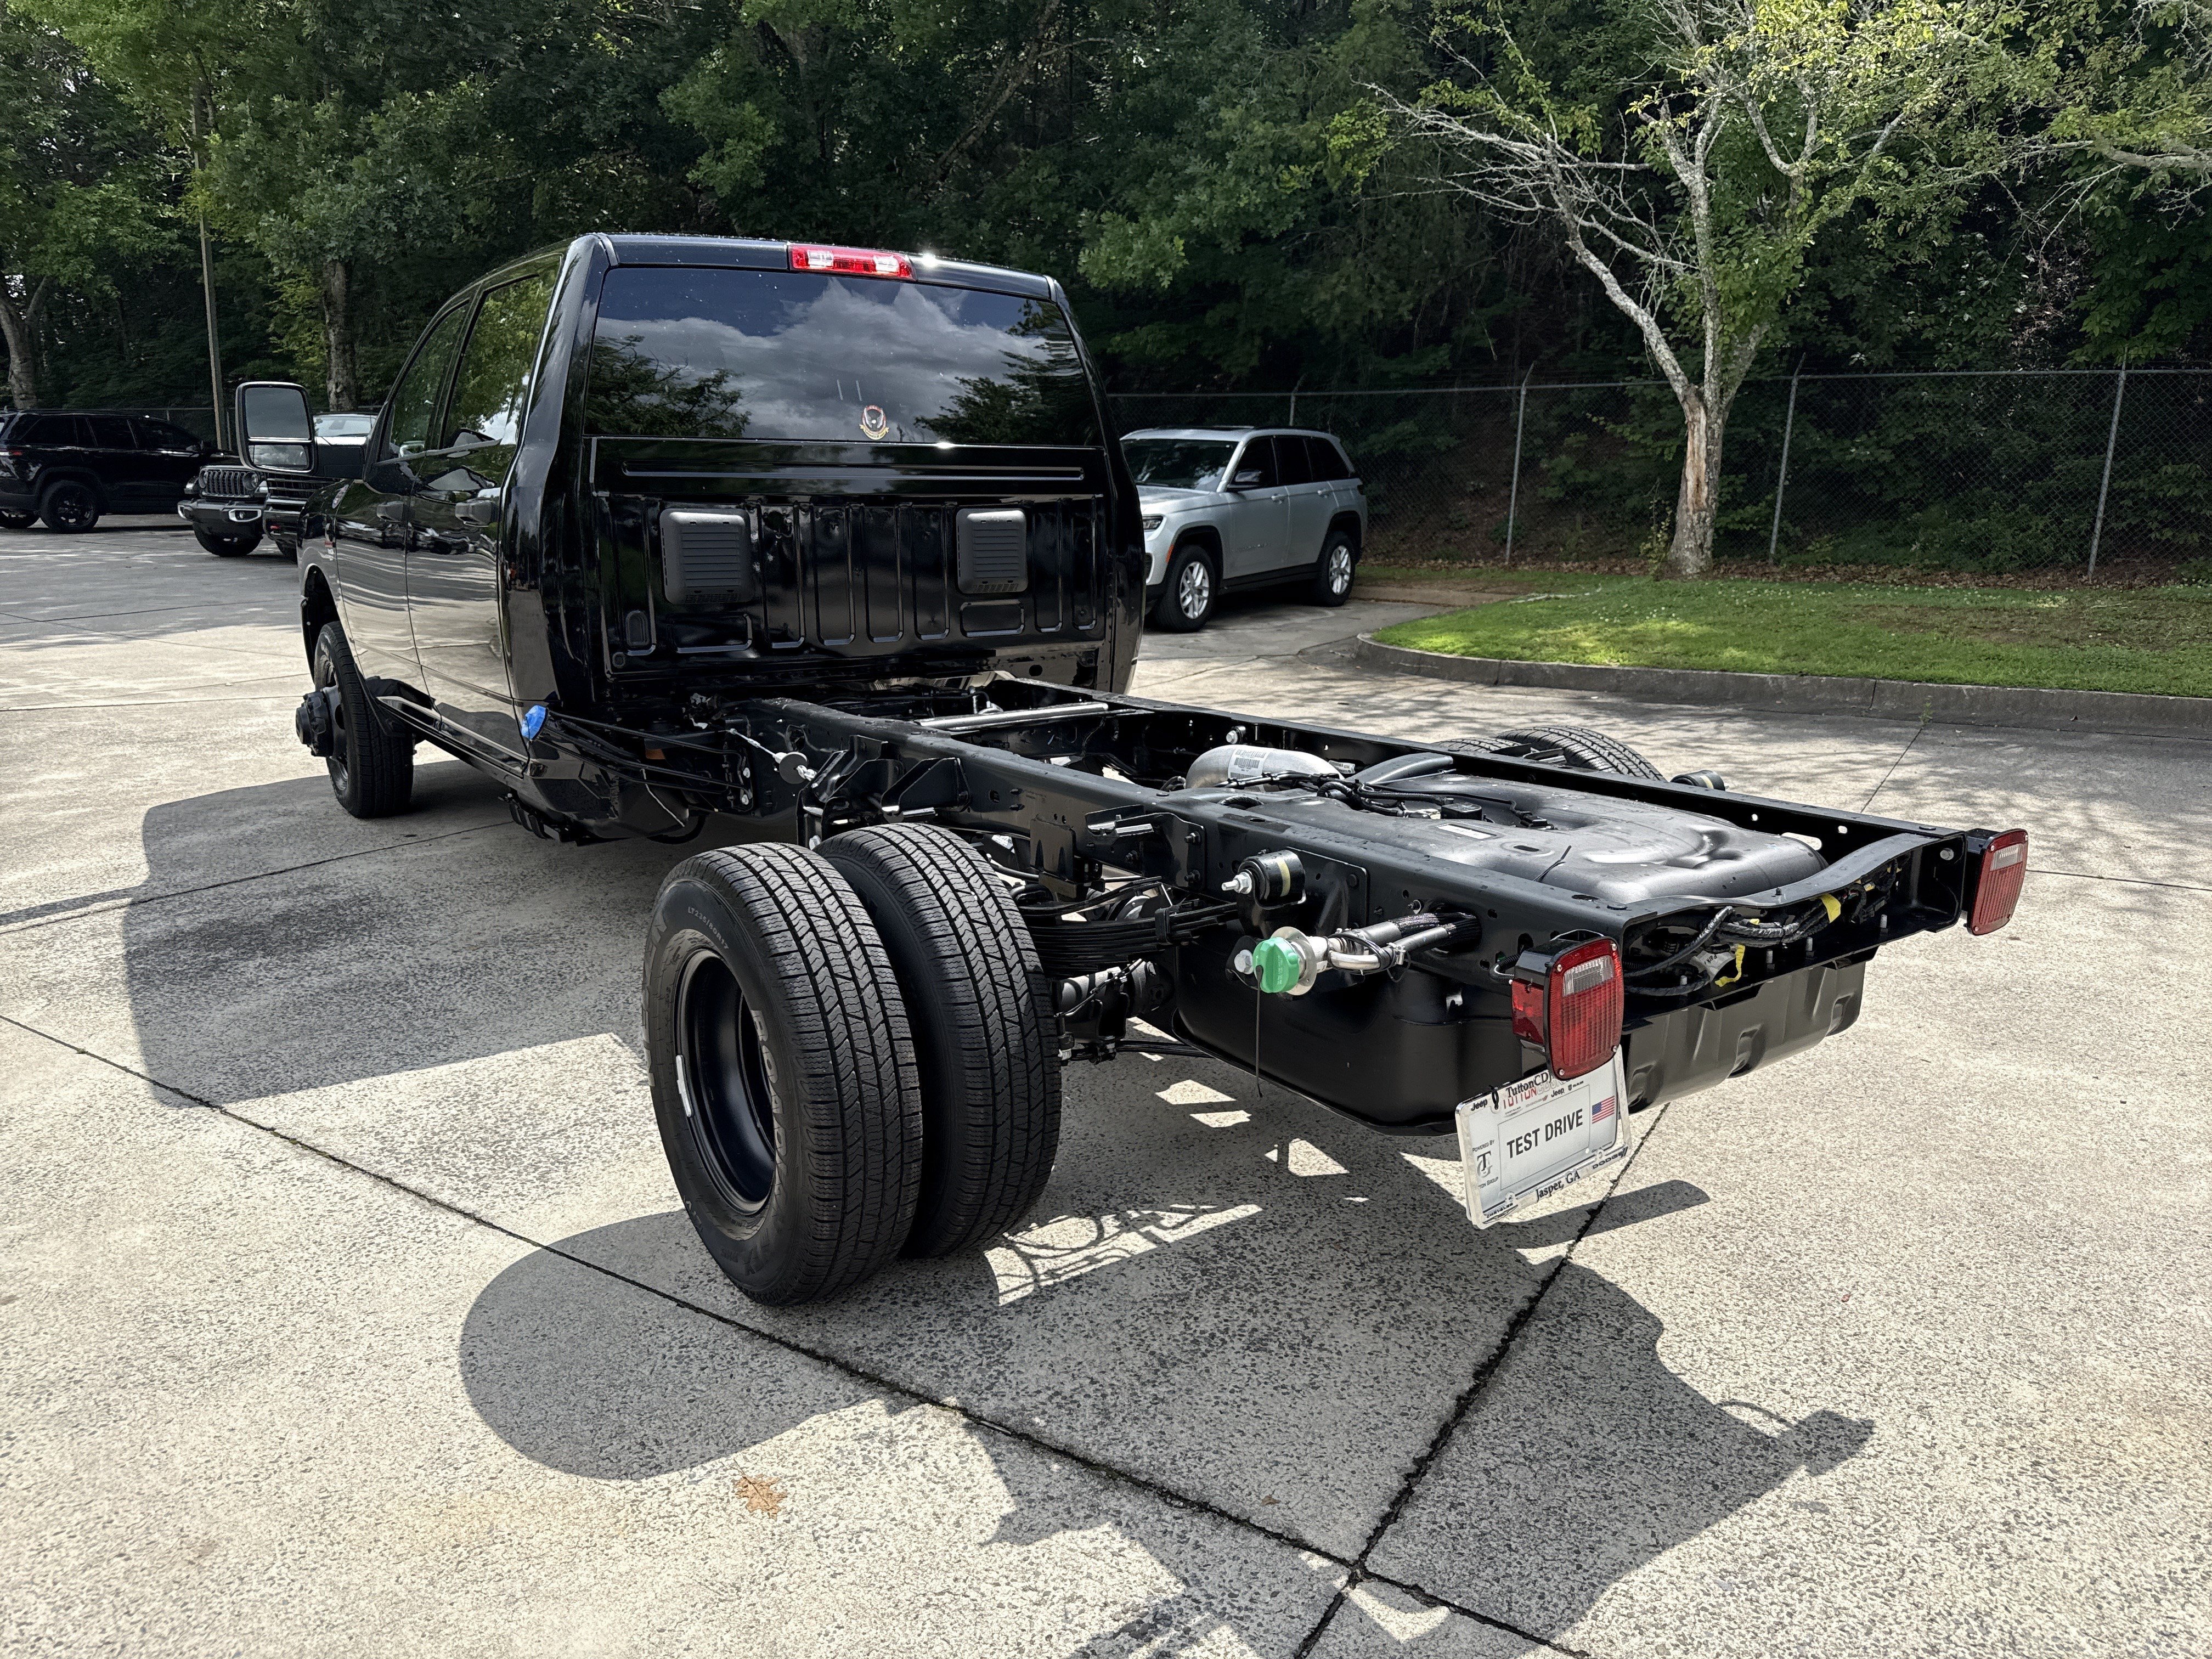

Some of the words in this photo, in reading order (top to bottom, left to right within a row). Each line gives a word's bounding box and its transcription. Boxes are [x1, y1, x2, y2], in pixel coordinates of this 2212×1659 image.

[687, 906, 729, 949] LT235/80R17
[1471, 1098, 1488, 1111] Jeep
[1551, 1087, 1565, 1098] Jeep
[1506, 1127, 1540, 1159] TEST
[1545, 1108, 1583, 1142] DRIVE
[1535, 1180, 1564, 1203] Jasper,
[1565, 1169, 1581, 1184] GA
